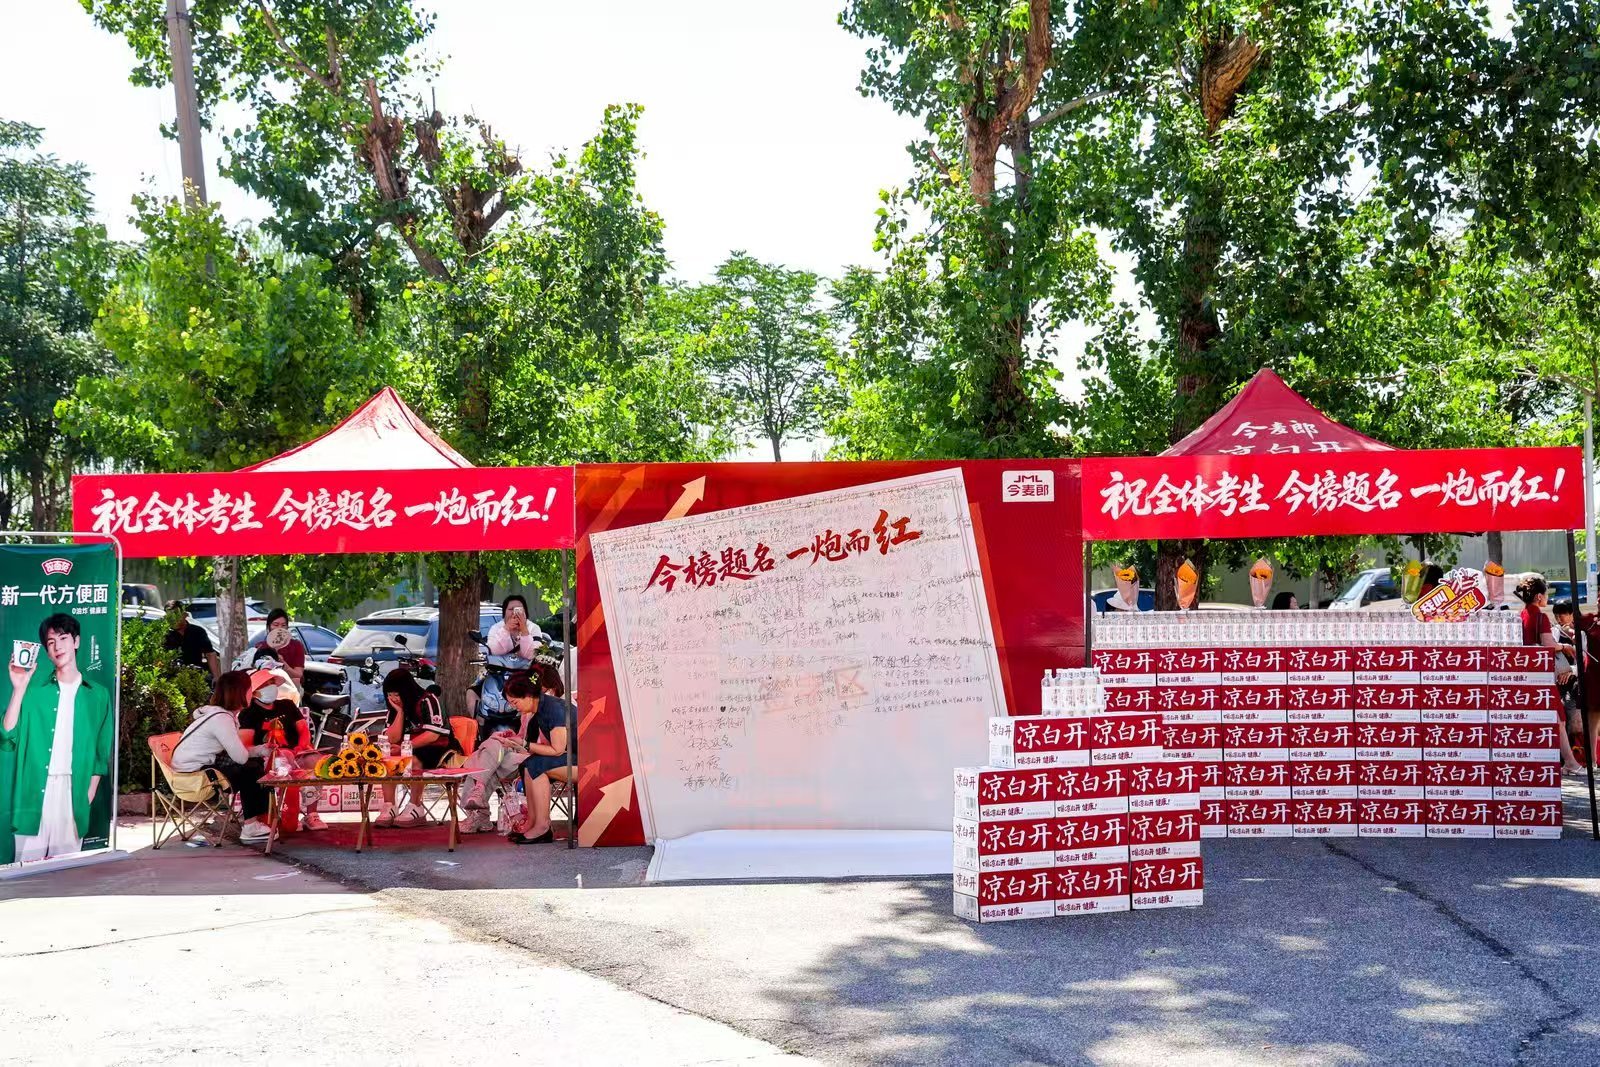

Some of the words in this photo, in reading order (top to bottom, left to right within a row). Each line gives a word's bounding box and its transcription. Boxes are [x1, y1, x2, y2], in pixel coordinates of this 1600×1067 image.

[1232, 420, 1319, 440] 今麦郎
[1013, 475, 1043, 483] JML
[1007, 484, 1049, 497] 今麦郎
[1100, 470, 1270, 520] 祝全体考生
[1273, 468, 1402, 516] 今榜题名
[91, 488, 263, 535] 祝全体考生
[267, 487, 397, 534] 今榜题名
[641, 542, 775, 593] 今榜题名
[786, 509, 924, 568] 一炮而红
[1, 584, 109, 606] 新一代方便面
[1094, 652, 1154, 673] 凉白开
[1159, 651, 1219, 671] 凉白开
[1224, 650, 1284, 671] 凉白开
[1290, 649, 1351, 670] 凉白开
[1357, 649, 1417, 670] 凉白开
[1423, 649, 1485, 670] 凉白开
[1491, 650, 1553, 670] 凉白开
[1158, 689, 1219, 709] 凉白开
[1224, 688, 1284, 708] 凉白开
[1289, 688, 1350, 708] 凉白开
[1357, 687, 1418, 708] 凉白开
[1423, 687, 1485, 708] 凉白开
[1491, 688, 1554, 709] 凉白开
[1017, 723, 1087, 749] 凉白开
[1094, 719, 1160, 745] 凉白开
[1162, 727, 1220, 747] 凉白开
[1226, 726, 1287, 746] 凉白开
[1291, 725, 1352, 746] 凉白开
[1358, 725, 1419, 746] 凉白开
[1426, 725, 1487, 746] 凉白开
[1494, 726, 1557, 747] 凉白开
[1057, 769, 1126, 797] 凉白开
[1132, 766, 1198, 792] 凉白开
[1227, 764, 1288, 784] 凉白开
[1294, 764, 1355, 784] 凉白开
[1360, 763, 1421, 784] 凉白开
[1427, 763, 1489, 784] 凉白开
[1496, 764, 1558, 785] 凉白开
[982, 773, 1052, 801] 凉白开
[1230, 802, 1290, 823] 凉白开
[1295, 802, 1356, 822] 凉白开
[1361, 801, 1423, 823] 凉白开
[1429, 802, 1491, 823] 凉白开
[1497, 803, 1560, 824] 凉白开
[982, 823, 1052, 851] 凉白开
[1056, 818, 1125, 846] 凉白开
[1132, 814, 1197, 841] 凉白开
[1057, 868, 1127, 895] 凉白开
[1134, 862, 1201, 889] 凉白开
[982, 873, 1052, 901] 凉白开
